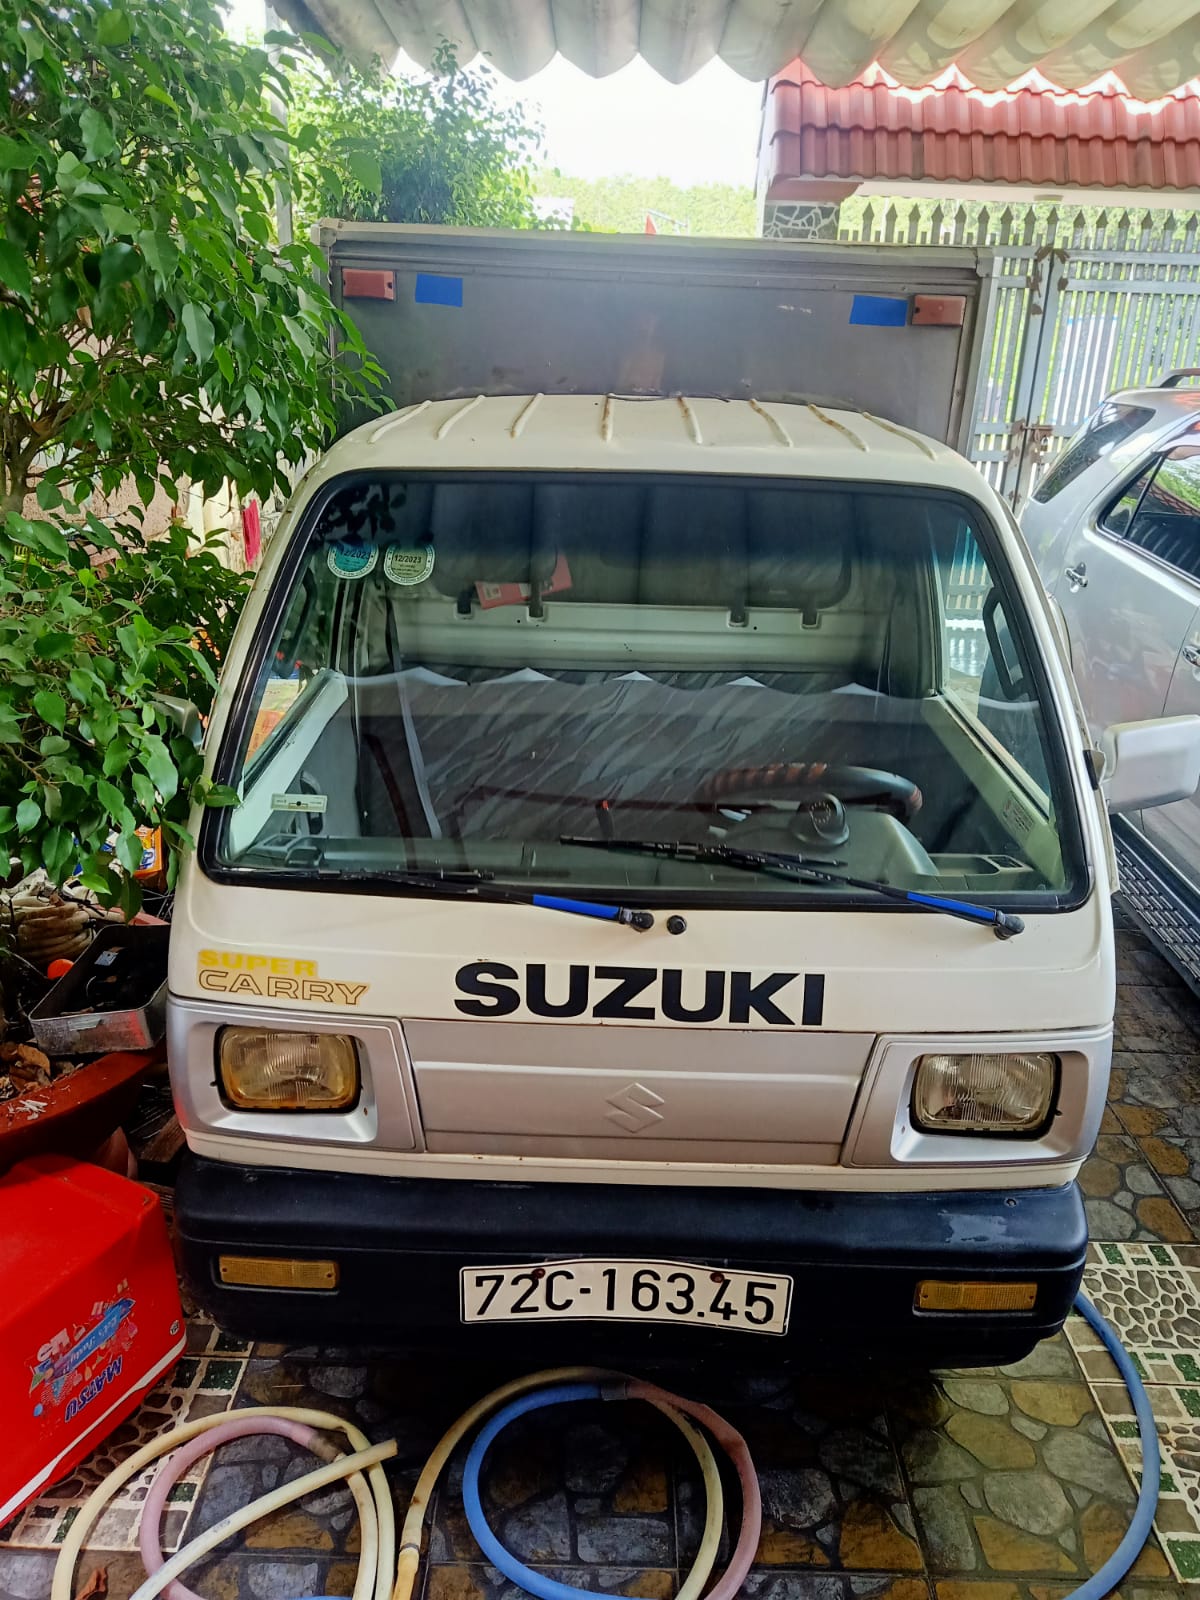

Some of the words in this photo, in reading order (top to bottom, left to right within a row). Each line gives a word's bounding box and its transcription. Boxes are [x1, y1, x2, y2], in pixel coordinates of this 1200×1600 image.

[394, 554, 422, 564] 12/2023
[199, 949, 317, 977] SUPER
[199, 969, 368, 1006] CARRY
[454, 961, 826, 1026] SUZUKI
[474, 1268, 778, 1325] 72C-163.45
[64, 1356, 123, 1422] MATSU
